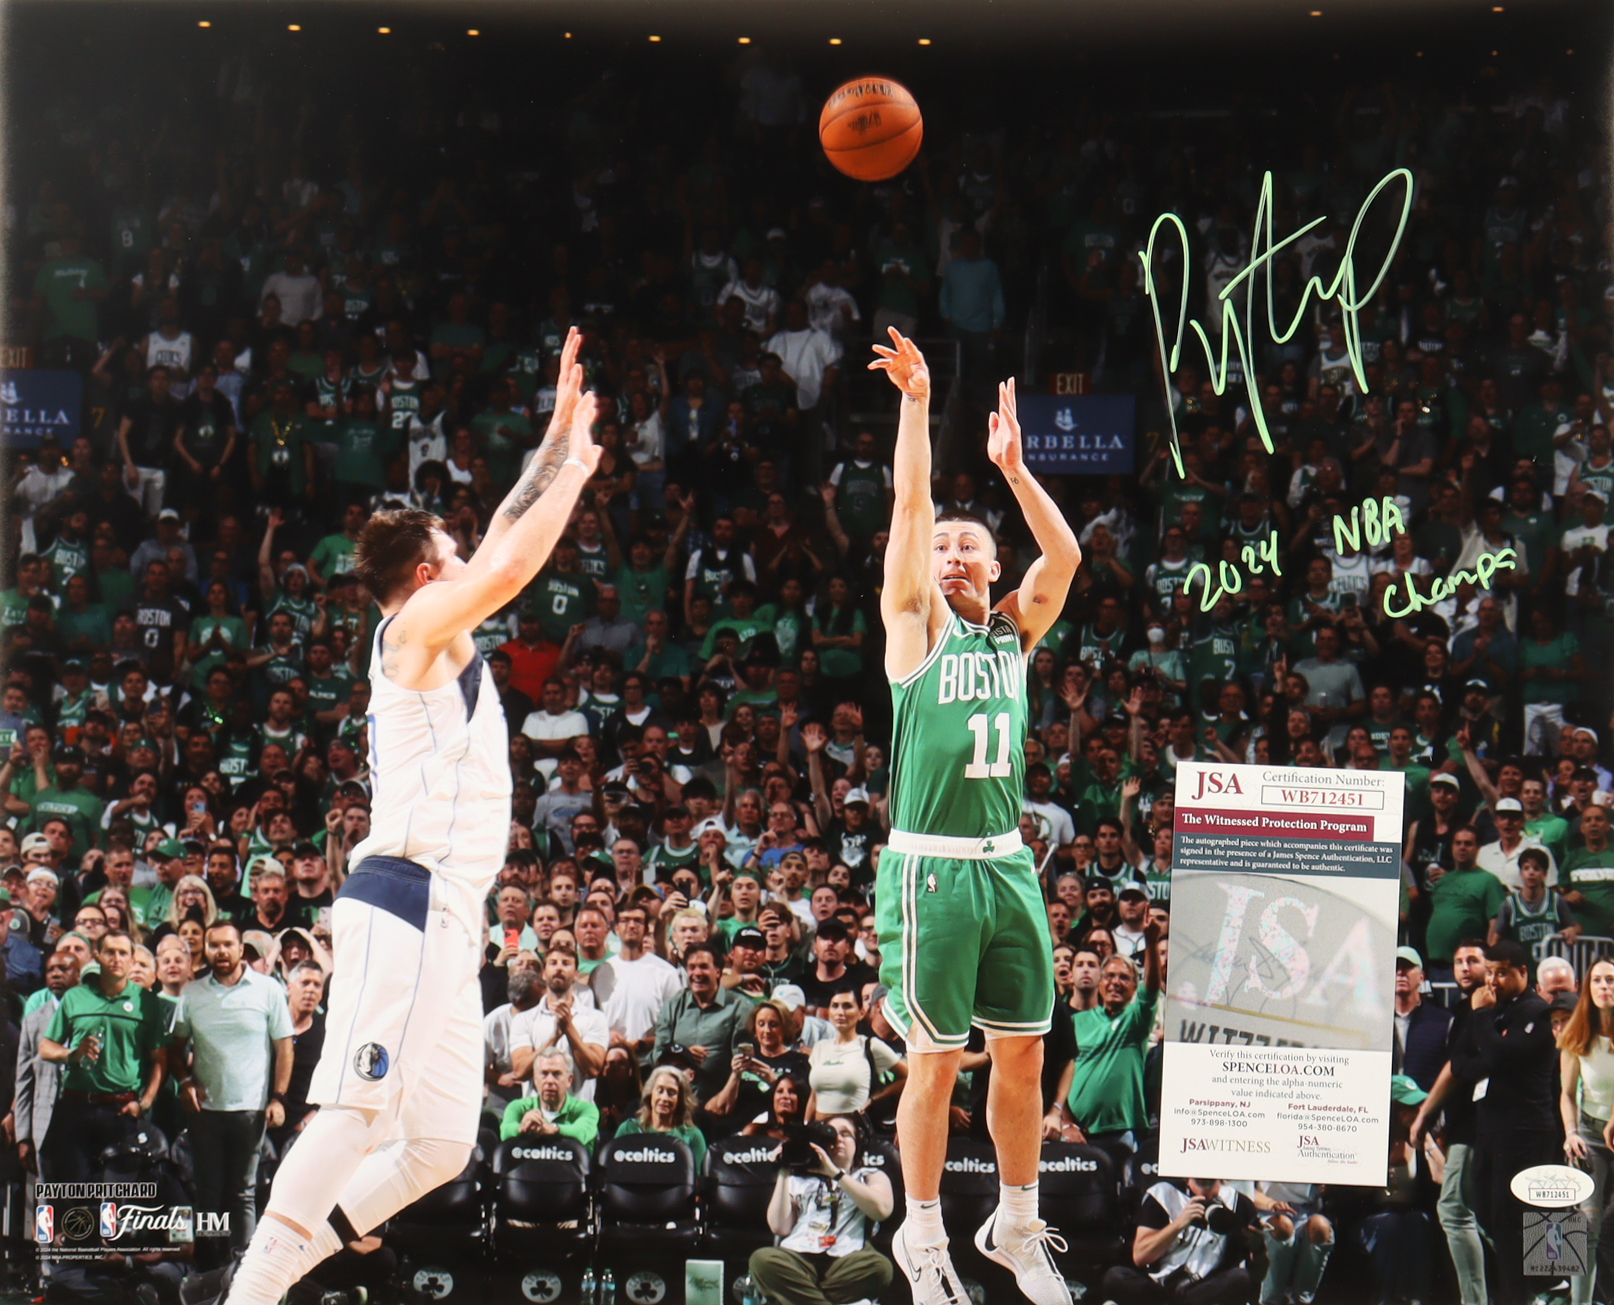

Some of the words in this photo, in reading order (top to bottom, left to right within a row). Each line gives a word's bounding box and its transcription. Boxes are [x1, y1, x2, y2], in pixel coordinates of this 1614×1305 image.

[1056, 373, 1085, 395] EXIT
[1024, 453, 1110, 461] NSURANCE
[1183, 530, 1282, 612] 2024
[1333, 496, 1406, 555] NBA
[552, 593, 568, 615] 0
[137, 608, 171, 627] BOSTON
[144, 628, 159, 649] 0
[995, 634, 1015, 645] PRINT
[1224, 659, 1237, 680] 7
[939, 652, 1018, 704] BOSTON
[964, 712, 1013, 778] 11
[1191, 771, 1243, 800] JSA
[1262, 771, 1331, 784] Certification
[1336, 774, 1384, 786] Number:
[1282, 789, 1362, 805] WB712451
[1182, 813, 1201, 824] The
[1204, 814, 1258, 826] Witnessed
[1262, 817, 1317, 829] Protection
[1320, 820, 1366, 833] Program
[1195, 838, 1239, 847] autographed
[1240, 839, 1258, 848] piece
[1283, 843, 1328, 851] accompanies
[1344, 844, 1378, 852] certificate
[1180, 847, 1203, 856] signed
[1272, 850, 1293, 859] James
[1295, 852, 1319, 861] Spence
[1321, 853, 1375, 863] Authentication,
[1376, 855, 1392, 863] LLC
[1180, 858, 1228, 866] representative
[1252, 861, 1290, 869] guaranteed
[1298, 862, 1308, 870] be
[1309, 863, 1345, 871] authentic.
[1519, 924, 1555, 943] BOSTON
[1210, 1049, 1236, 1060] Verify
[1237, 1050, 1252, 1059] this
[1254, 1053, 1303, 1061] certification
[1306, 1053, 1316, 1064] by
[1318, 1055, 1349, 1065] visiting
[1223, 1062, 1334, 1076] SPENCELOA.COM
[1212, 1075, 1227, 1083] and
[1230, 1077, 1264, 1087] entering
[1266, 1077, 1279, 1085] the
[1282, 1078, 1343, 1089] alpha-numeric
[1231, 1088, 1253, 1096] value
[1255, 1089, 1291, 1099] indicated
[1294, 1092, 1321, 1100] above.
[1189, 1098, 1237, 1108] Parsippany,
[1308, 1104, 1356, 1113] Lauderdale,
[1174, 1108, 1265, 1118] info@SpenceLOA.com
[1277, 1112, 1378, 1123] florida@SpenceLOA.com
[1191, 1118, 1247, 1127] 973-898-1300
[1298, 1123, 1357, 1132] 954-380-8670
[1180, 1138, 1270, 1153] JSAWITNESS
[1297, 1135, 1318, 1149] JSA
[511, 1145, 573, 1161] @celtics
[618, 1146, 680, 1163] @celtics
[1298, 1149, 1354, 1159] Authentication
[944, 1156, 996, 1173] celtics
[1536, 1190, 1570, 1198] WB712451
